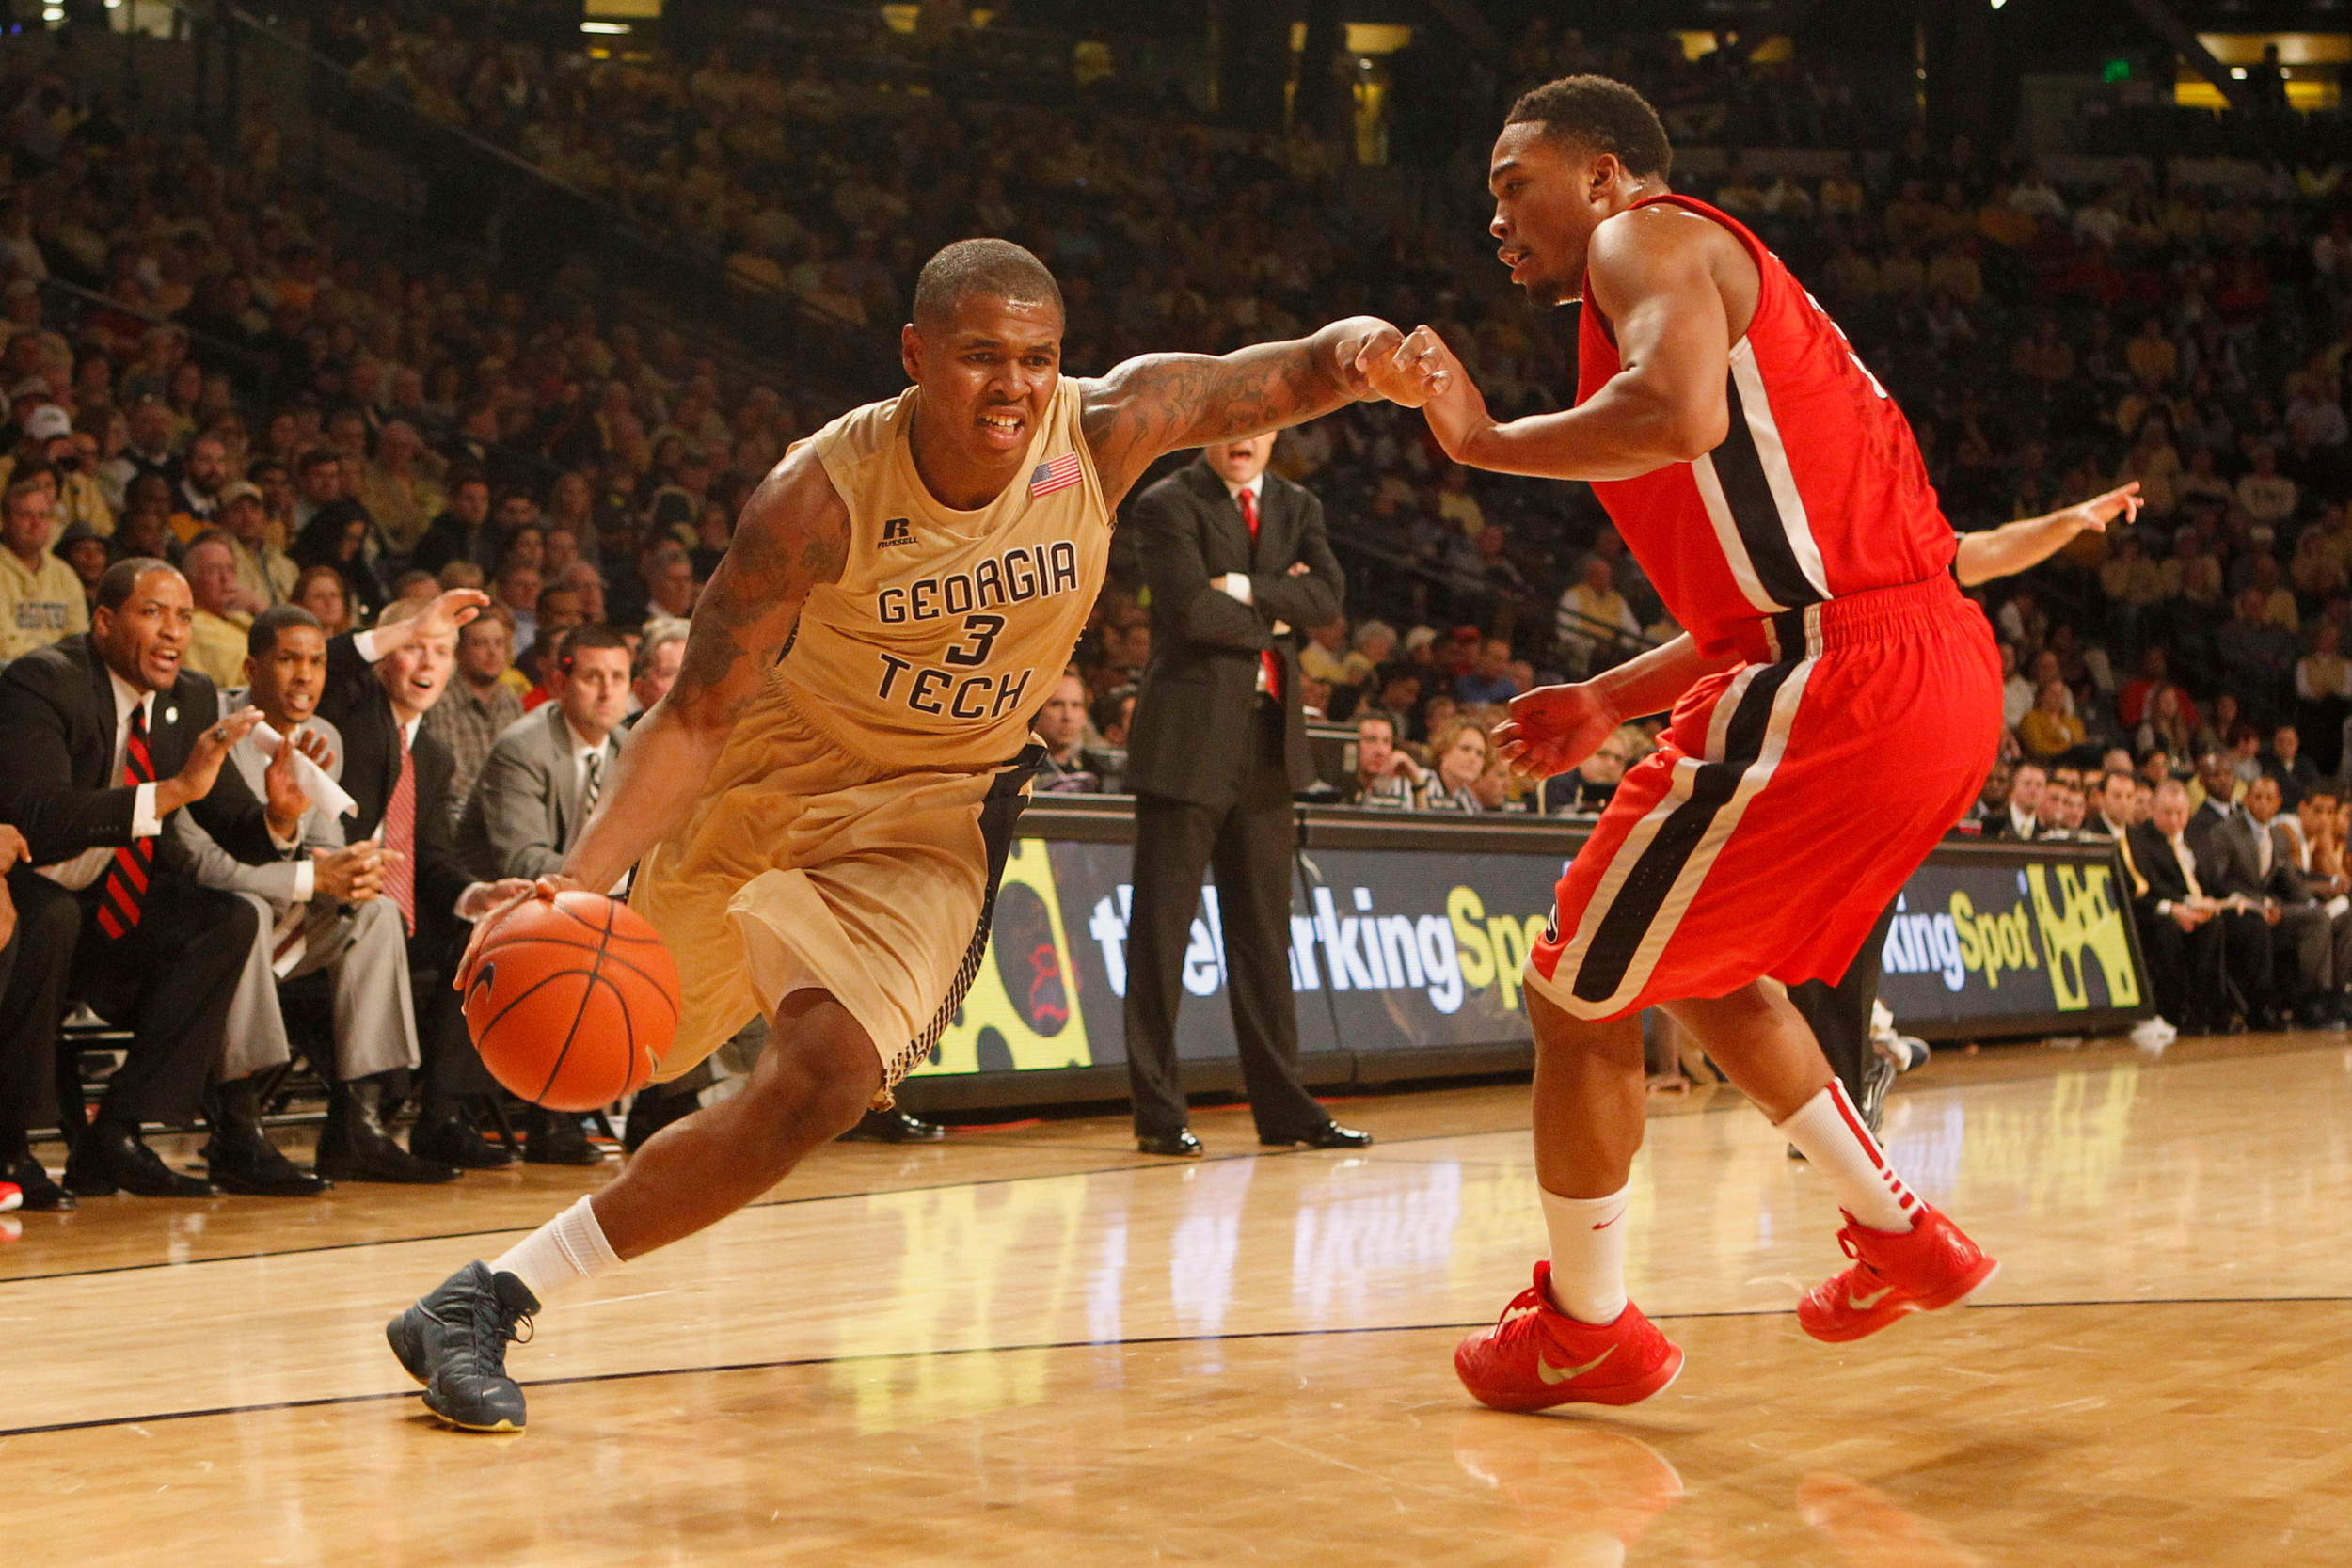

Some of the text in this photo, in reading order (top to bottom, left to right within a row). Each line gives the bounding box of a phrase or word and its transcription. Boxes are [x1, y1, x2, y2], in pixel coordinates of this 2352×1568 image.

[877, 537, 918, 549] RUSSELL
[878, 541, 1078, 625] GEORGIA
[944, 613, 1007, 667] 3
[878, 651, 1034, 720] TECH
